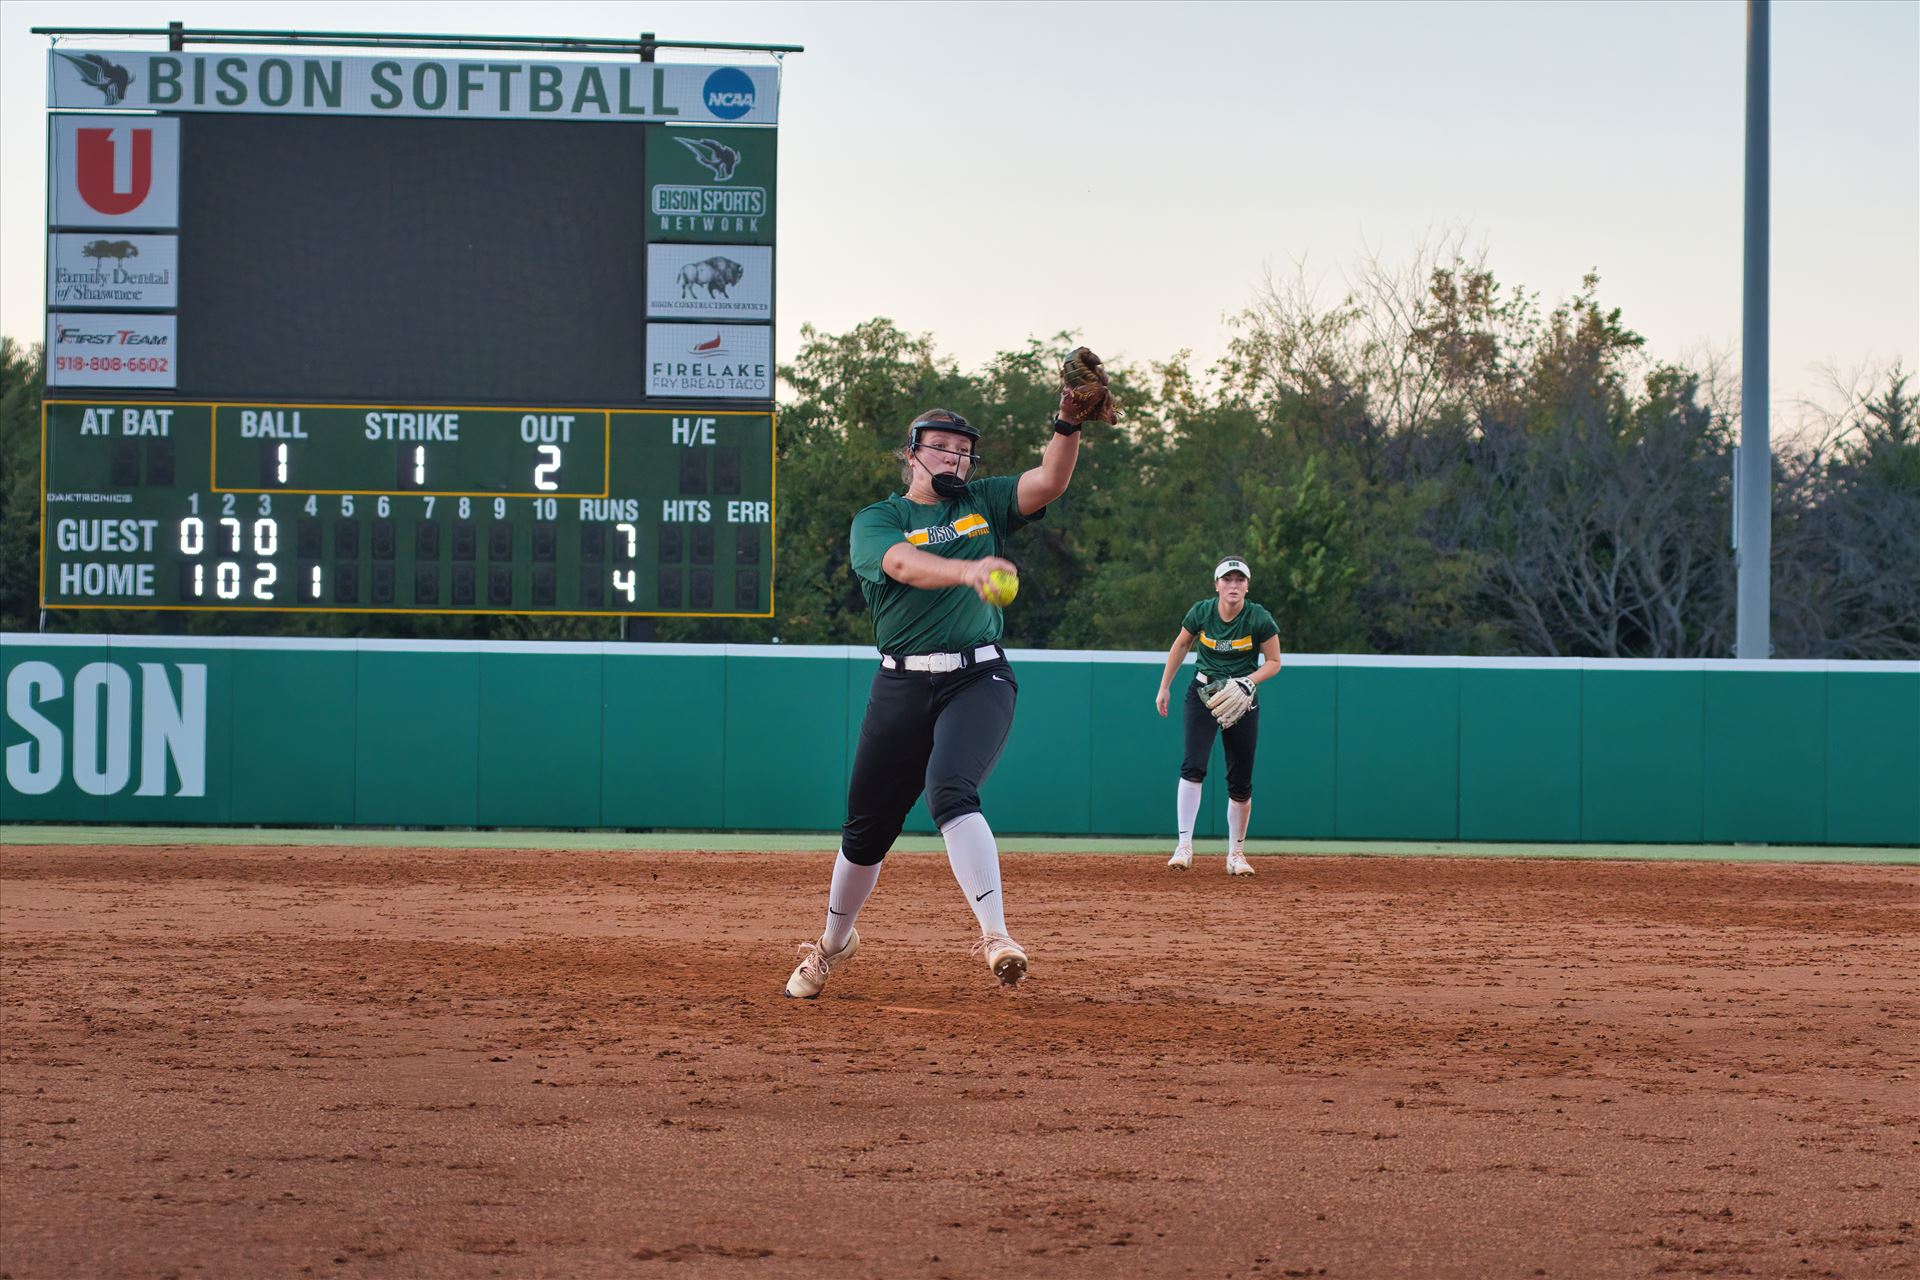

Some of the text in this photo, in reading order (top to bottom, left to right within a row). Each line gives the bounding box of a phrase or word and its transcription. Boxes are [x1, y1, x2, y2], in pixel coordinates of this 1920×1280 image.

[147, 56, 680, 116] BISON SOFTBALL
[708, 92, 753, 107] NCAA
[659, 190, 761, 213] BISON SPORTS
[660, 216, 758, 232] NETWORK
[56, 267, 169, 287] Family Dental
[57, 284, 143, 301] of Shawnee
[57, 328, 169, 346] FIRST TEAM
[652, 363, 766, 378] FIRELAKE
[653, 378, 766, 391] FRY BREAD TACO
[80, 408, 174, 437] AT BAT
[240, 410, 308, 439] BALL
[364, 412, 459, 441] STRIKE
[520, 415, 575, 443] OUT
[671, 418, 717, 448] H/E
[277, 443, 288, 484] 1
[415, 445, 425, 485] 1
[534, 445, 562, 491] 2
[187, 493, 770, 523] 1 2 3 4 5 6 7 8 9 10 RUNS HITS ERR
[56, 518, 159, 552] GUEST
[180, 517, 278, 556] 0 7 0
[616, 524, 636, 558] 7
[926, 521, 960, 544] BISON
[59, 562, 156, 596] HOME
[194, 561, 321, 600] 1 0 2 1
[612, 569, 636, 603] 4
[5, 660, 208, 797] SON
